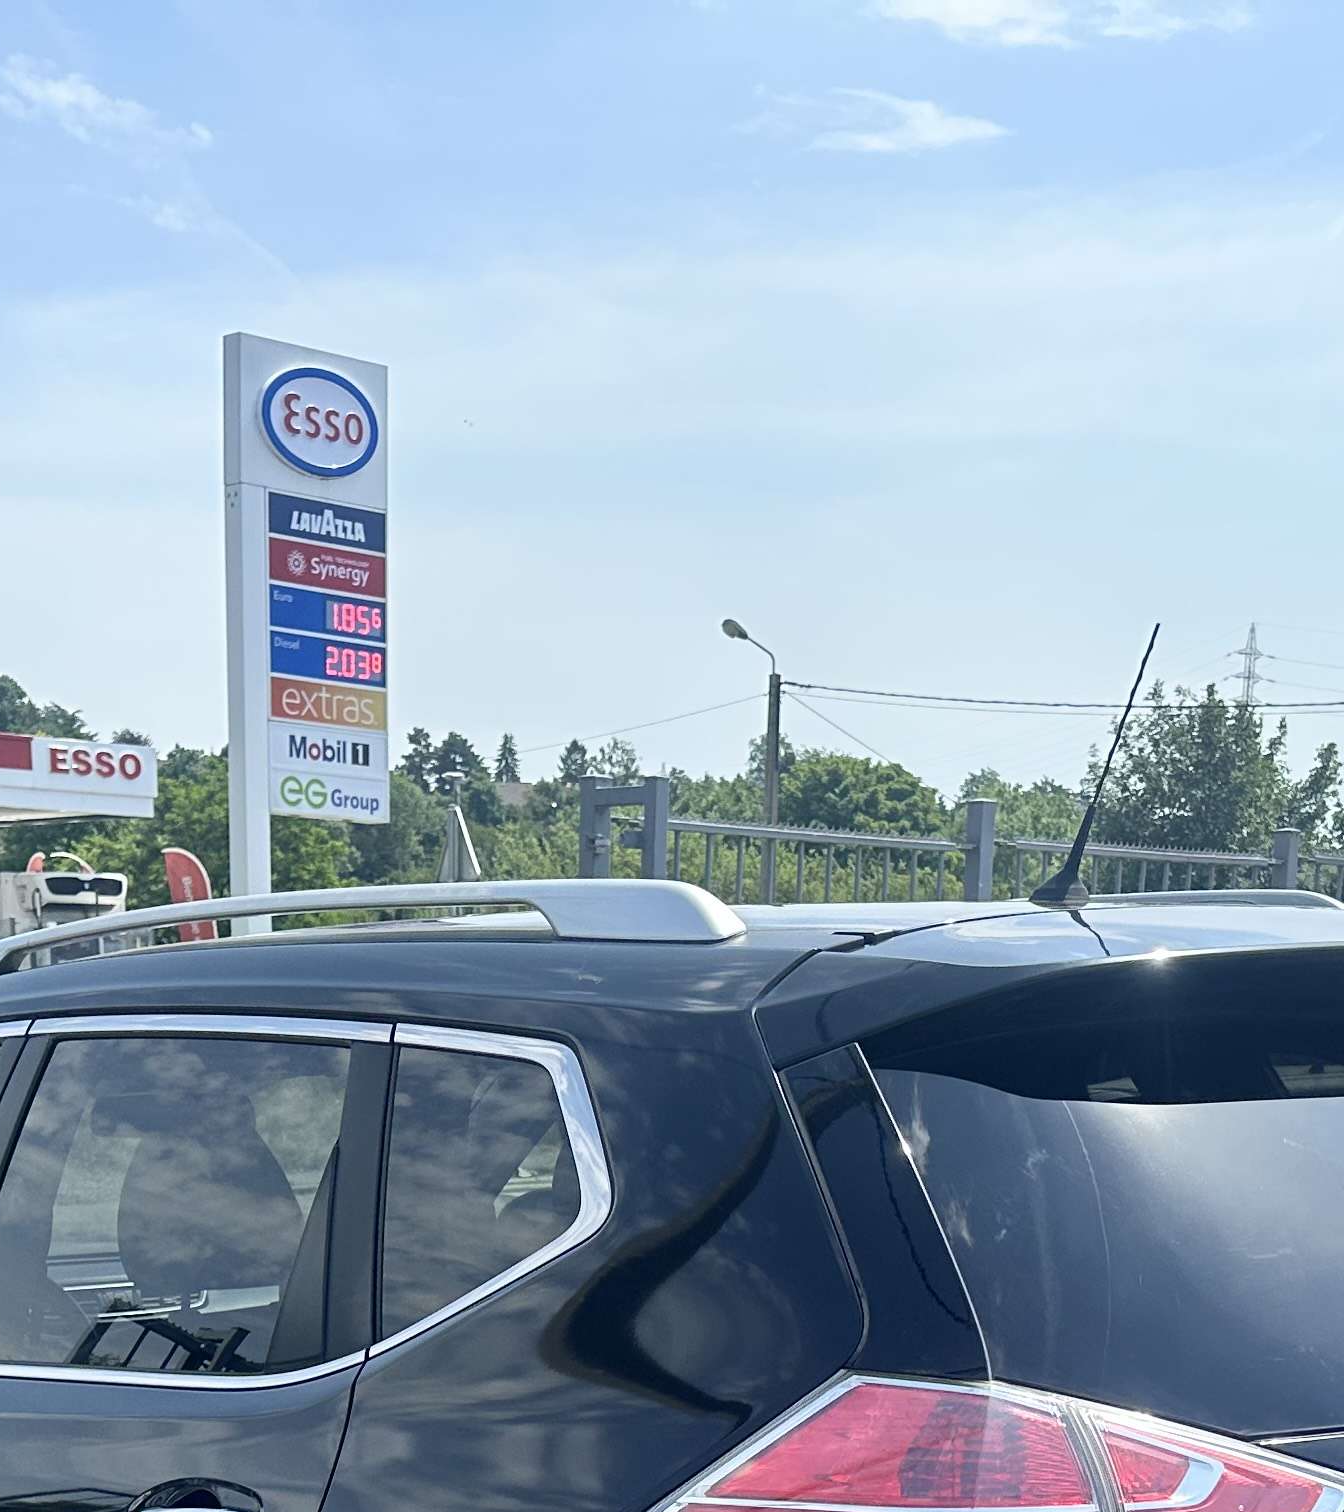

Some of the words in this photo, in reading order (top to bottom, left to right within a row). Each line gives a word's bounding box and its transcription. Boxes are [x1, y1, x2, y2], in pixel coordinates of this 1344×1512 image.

[311, 557, 370, 587] Synergy
[274, 636, 300, 650] Diesel
[49, 747, 142, 780] ESSO
[288, 734, 347, 765] Mobil
[353, 743, 369, 766] 1
[331, 788, 380, 815] Group
